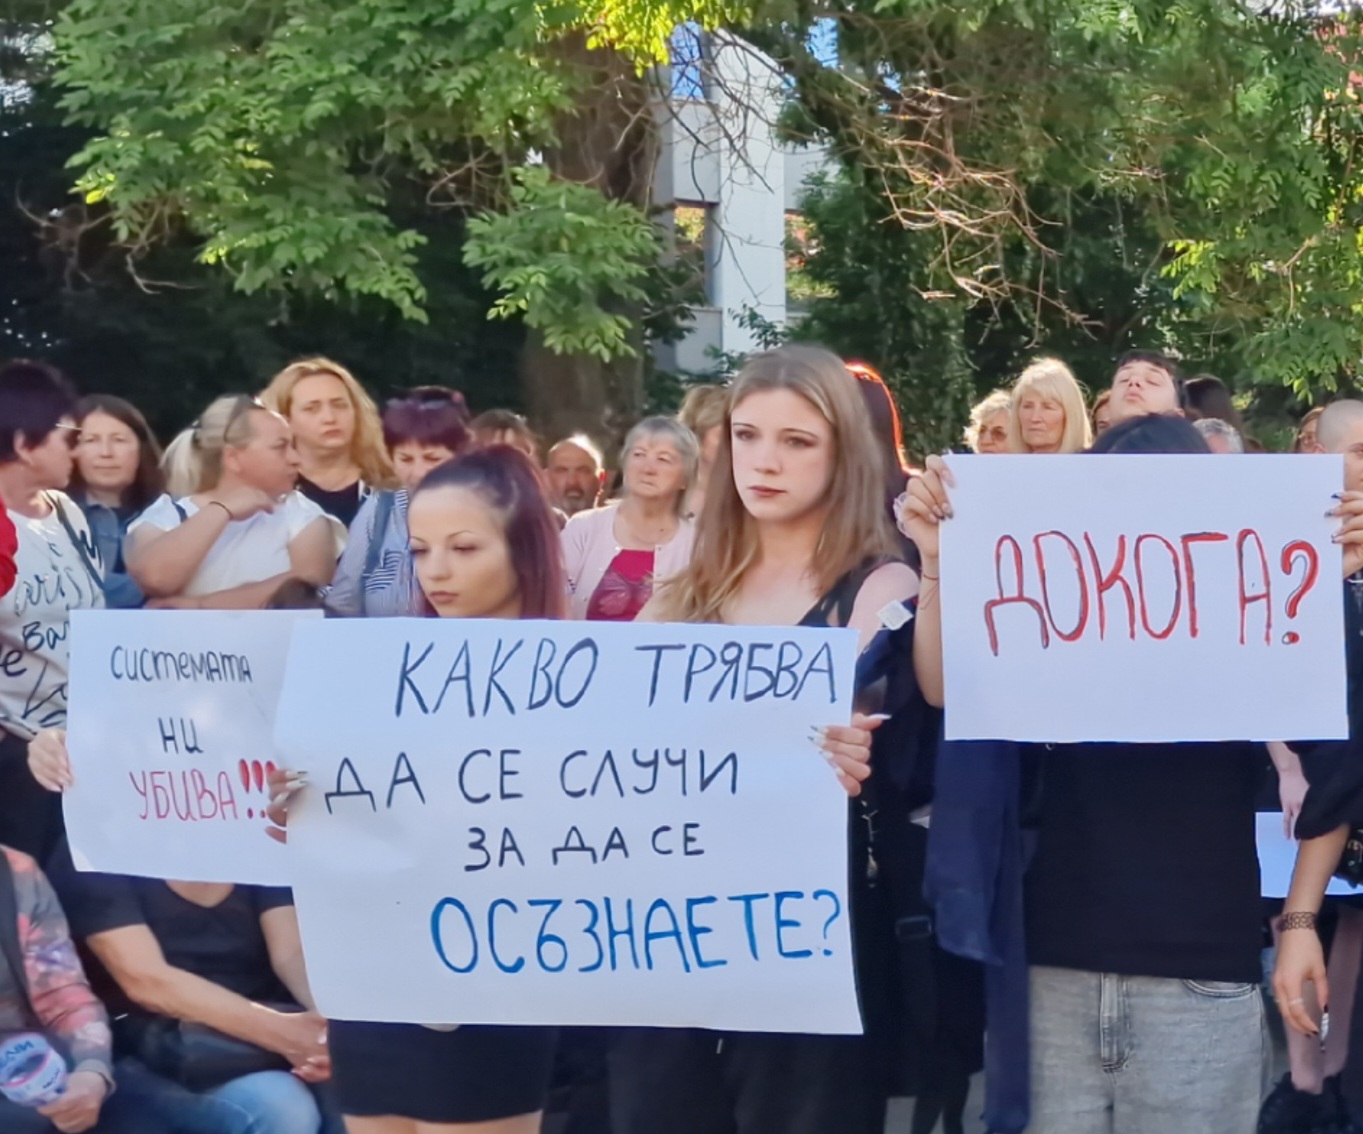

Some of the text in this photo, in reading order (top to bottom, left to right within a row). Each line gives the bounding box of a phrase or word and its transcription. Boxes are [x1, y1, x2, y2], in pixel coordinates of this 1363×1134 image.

[984, 528, 1319, 657] ДОКОГА?
[394, 637, 838, 717] КАКВО ТРЯБВА
[323, 747, 739, 814] ДА СЕ СЛУЧИ
[464, 823, 705, 873] ЗА ДА СЕ
[430, 889, 841, 975] ОСЪЗНАЕТЕ?
